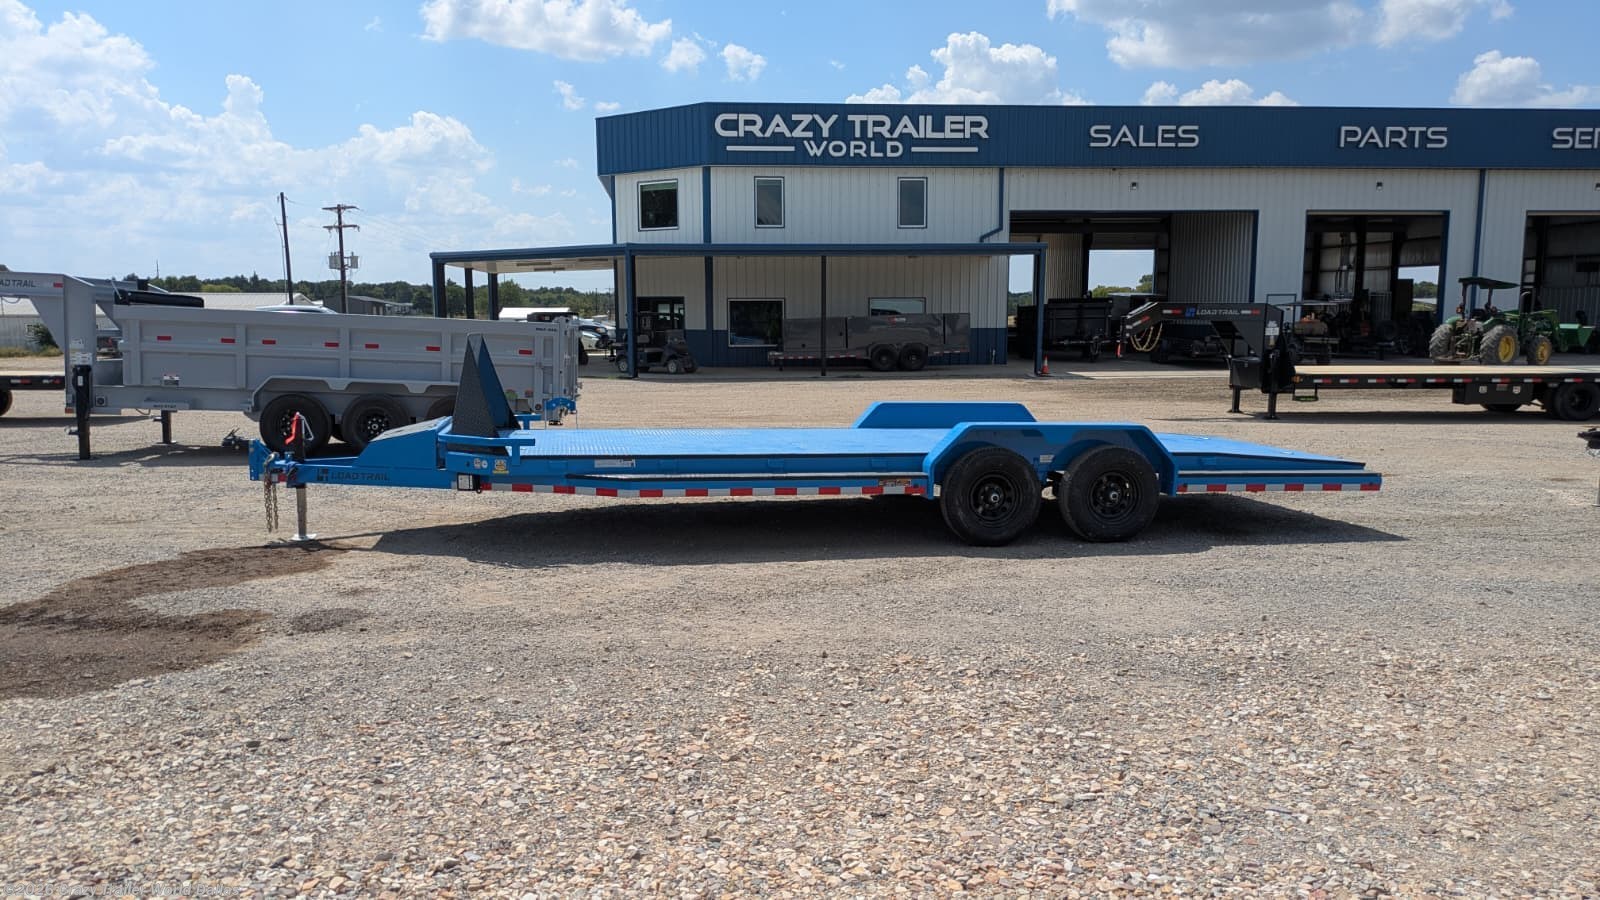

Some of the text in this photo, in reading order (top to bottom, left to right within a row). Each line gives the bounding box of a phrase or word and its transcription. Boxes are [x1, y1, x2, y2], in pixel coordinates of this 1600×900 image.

[714, 113, 989, 139] CRAZY TRAILER
[1089, 125, 1199, 148] SALES
[1339, 126, 1448, 149] PARTS
[803, 140, 904, 158] WORLD
